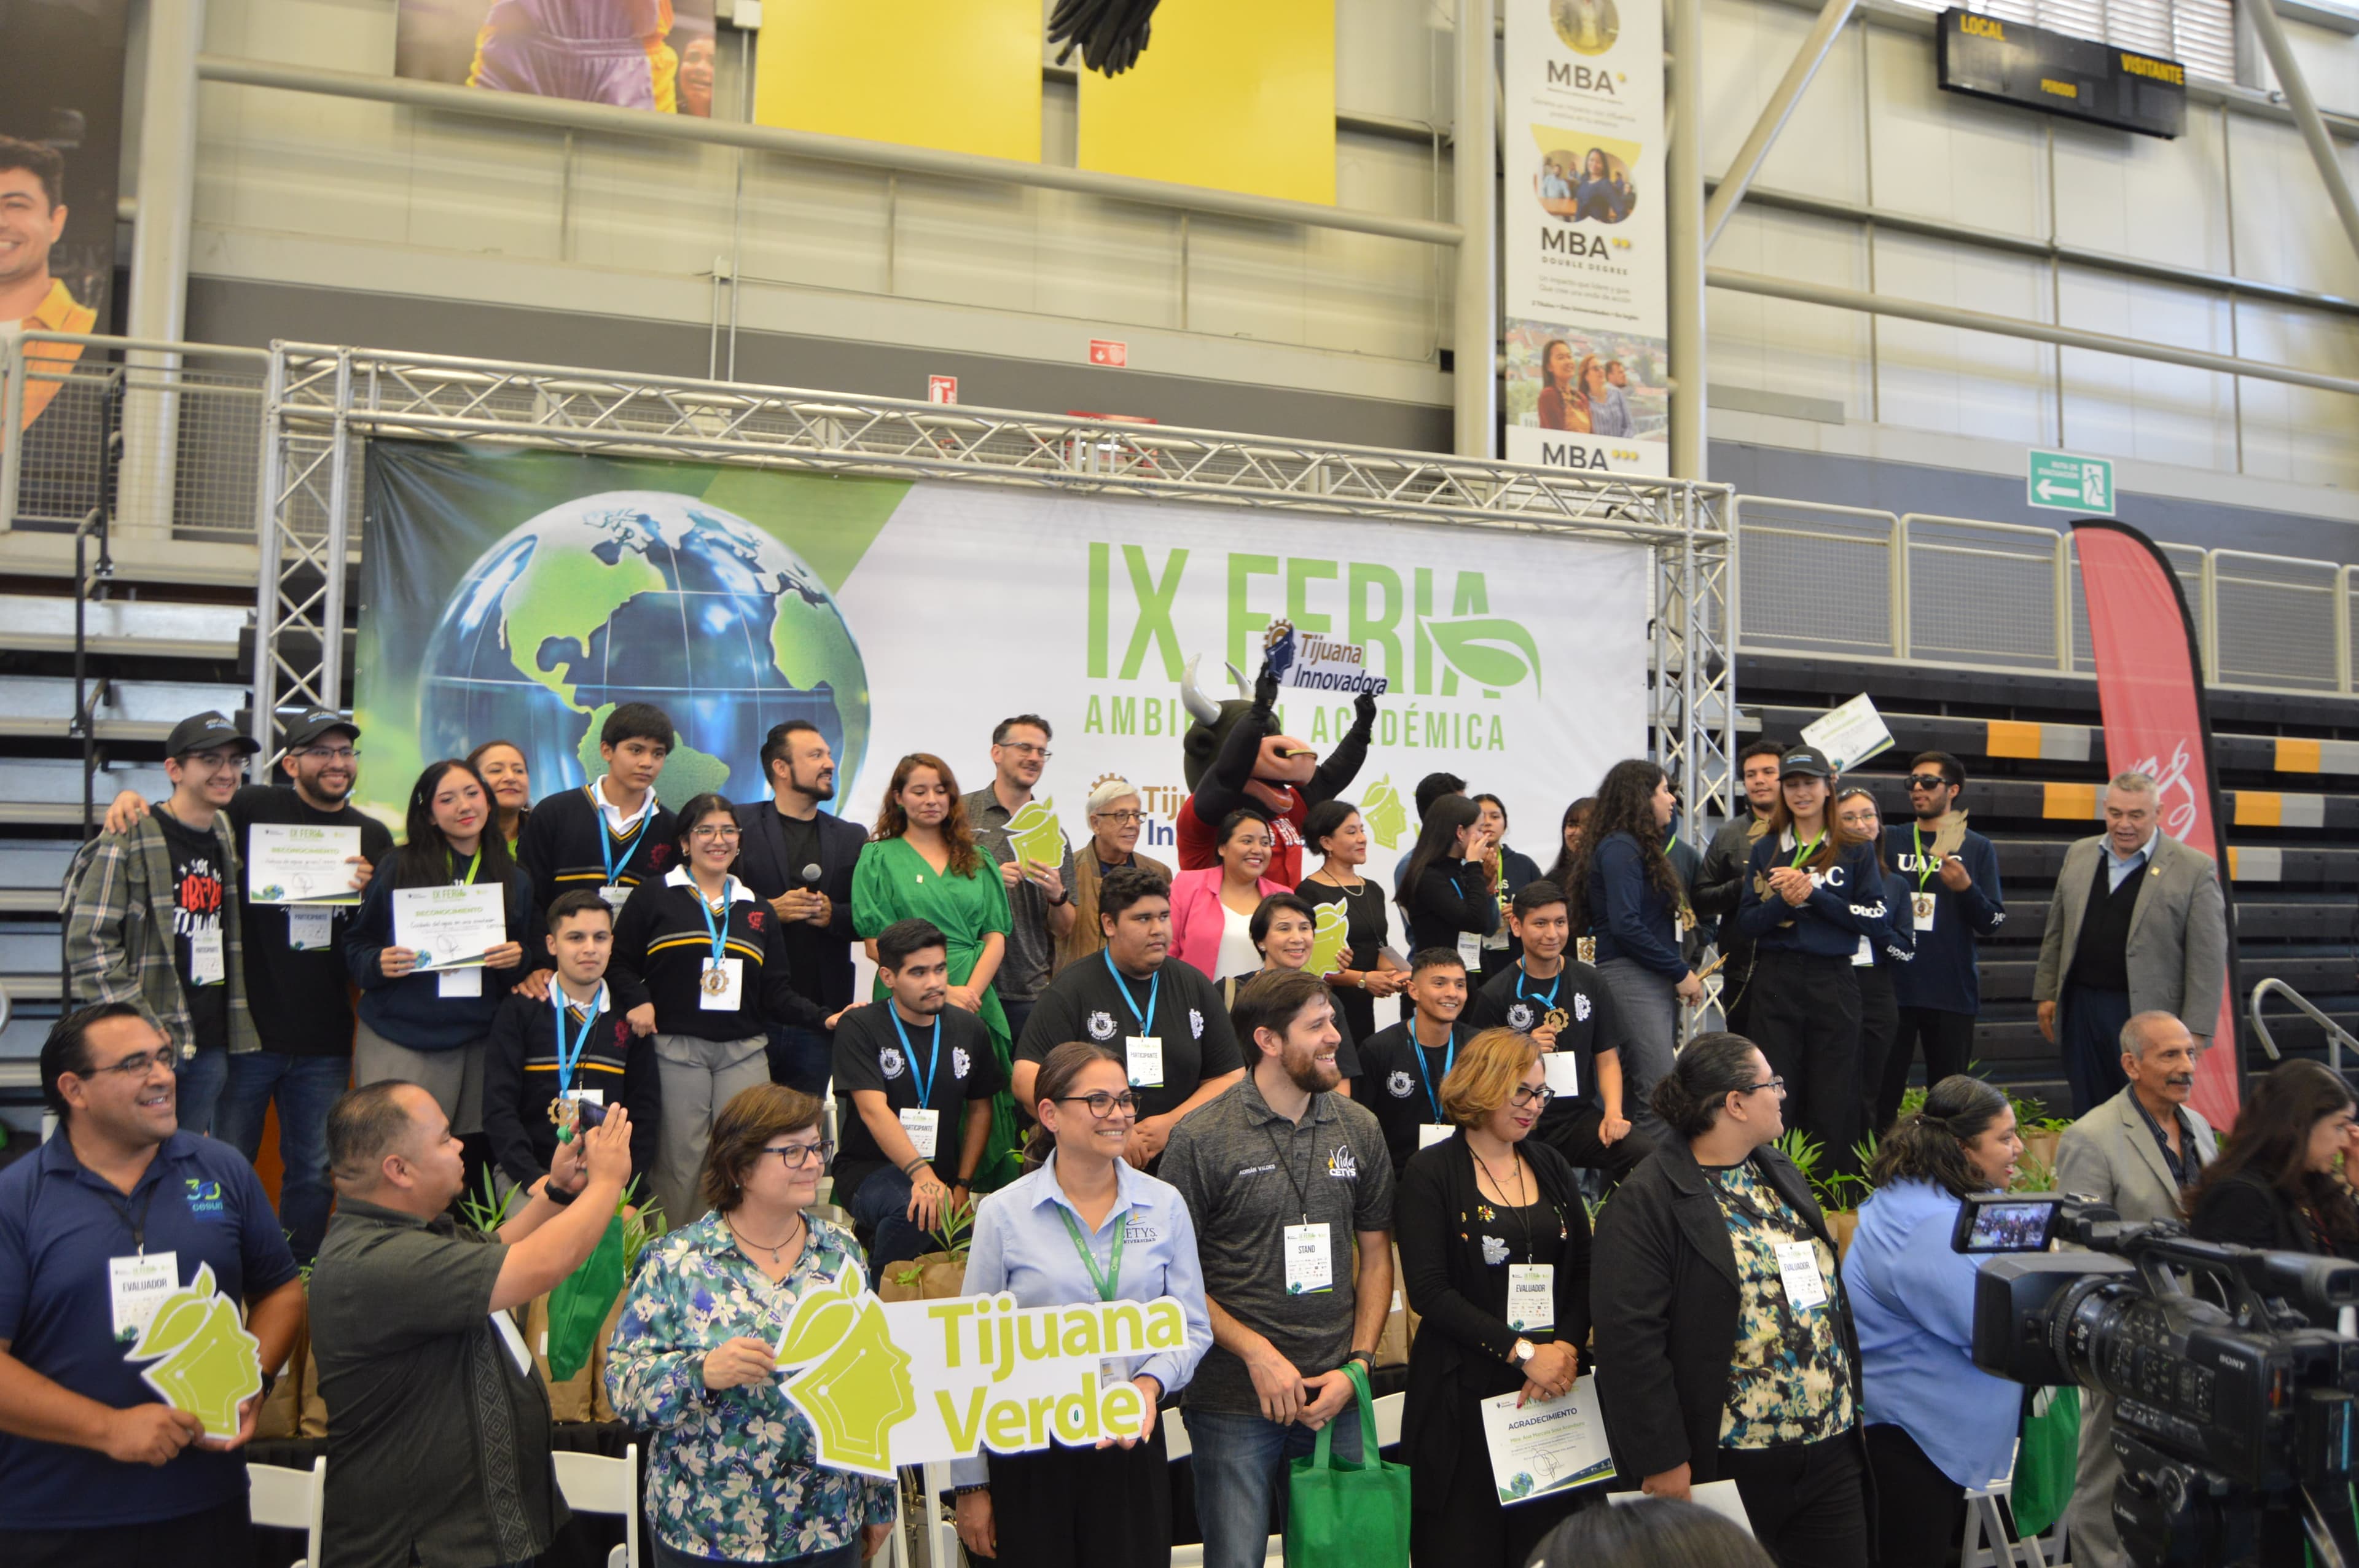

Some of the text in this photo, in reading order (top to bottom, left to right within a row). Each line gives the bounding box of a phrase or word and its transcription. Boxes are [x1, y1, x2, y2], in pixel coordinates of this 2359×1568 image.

[1960, 14, 2005, 41] LOCAL
[1547, 60, 1615, 95] MBA
[2120, 53, 2185, 85] VISITANTE
[1541, 227, 1610, 260] MBA
[1541, 256, 1628, 276] DOUBLE DEGREE
[1543, 442, 1609, 471] MBA
[1087, 542, 1502, 699] IX FERIA
[1301, 633, 1362, 666] Tijuana
[1294, 663, 1388, 695] Innovadora
[1310, 702, 1504, 751] ACDÉMICA
[1898, 853, 1962, 872] UAB
[1329, 1168, 1356, 1177] CETYS
[1124, 1227, 1157, 1238] ETYS
[1298, 1245, 1316, 1254] STAND
[123, 1278, 167, 1293] EVALUADOR
[928, 1297, 1184, 1383] Tijuana
[2219, 1353, 2246, 1370] SONY
[934, 1371, 1140, 1454] Verde
[1508, 1407, 1578, 1430] AGRADECIMIENTO
